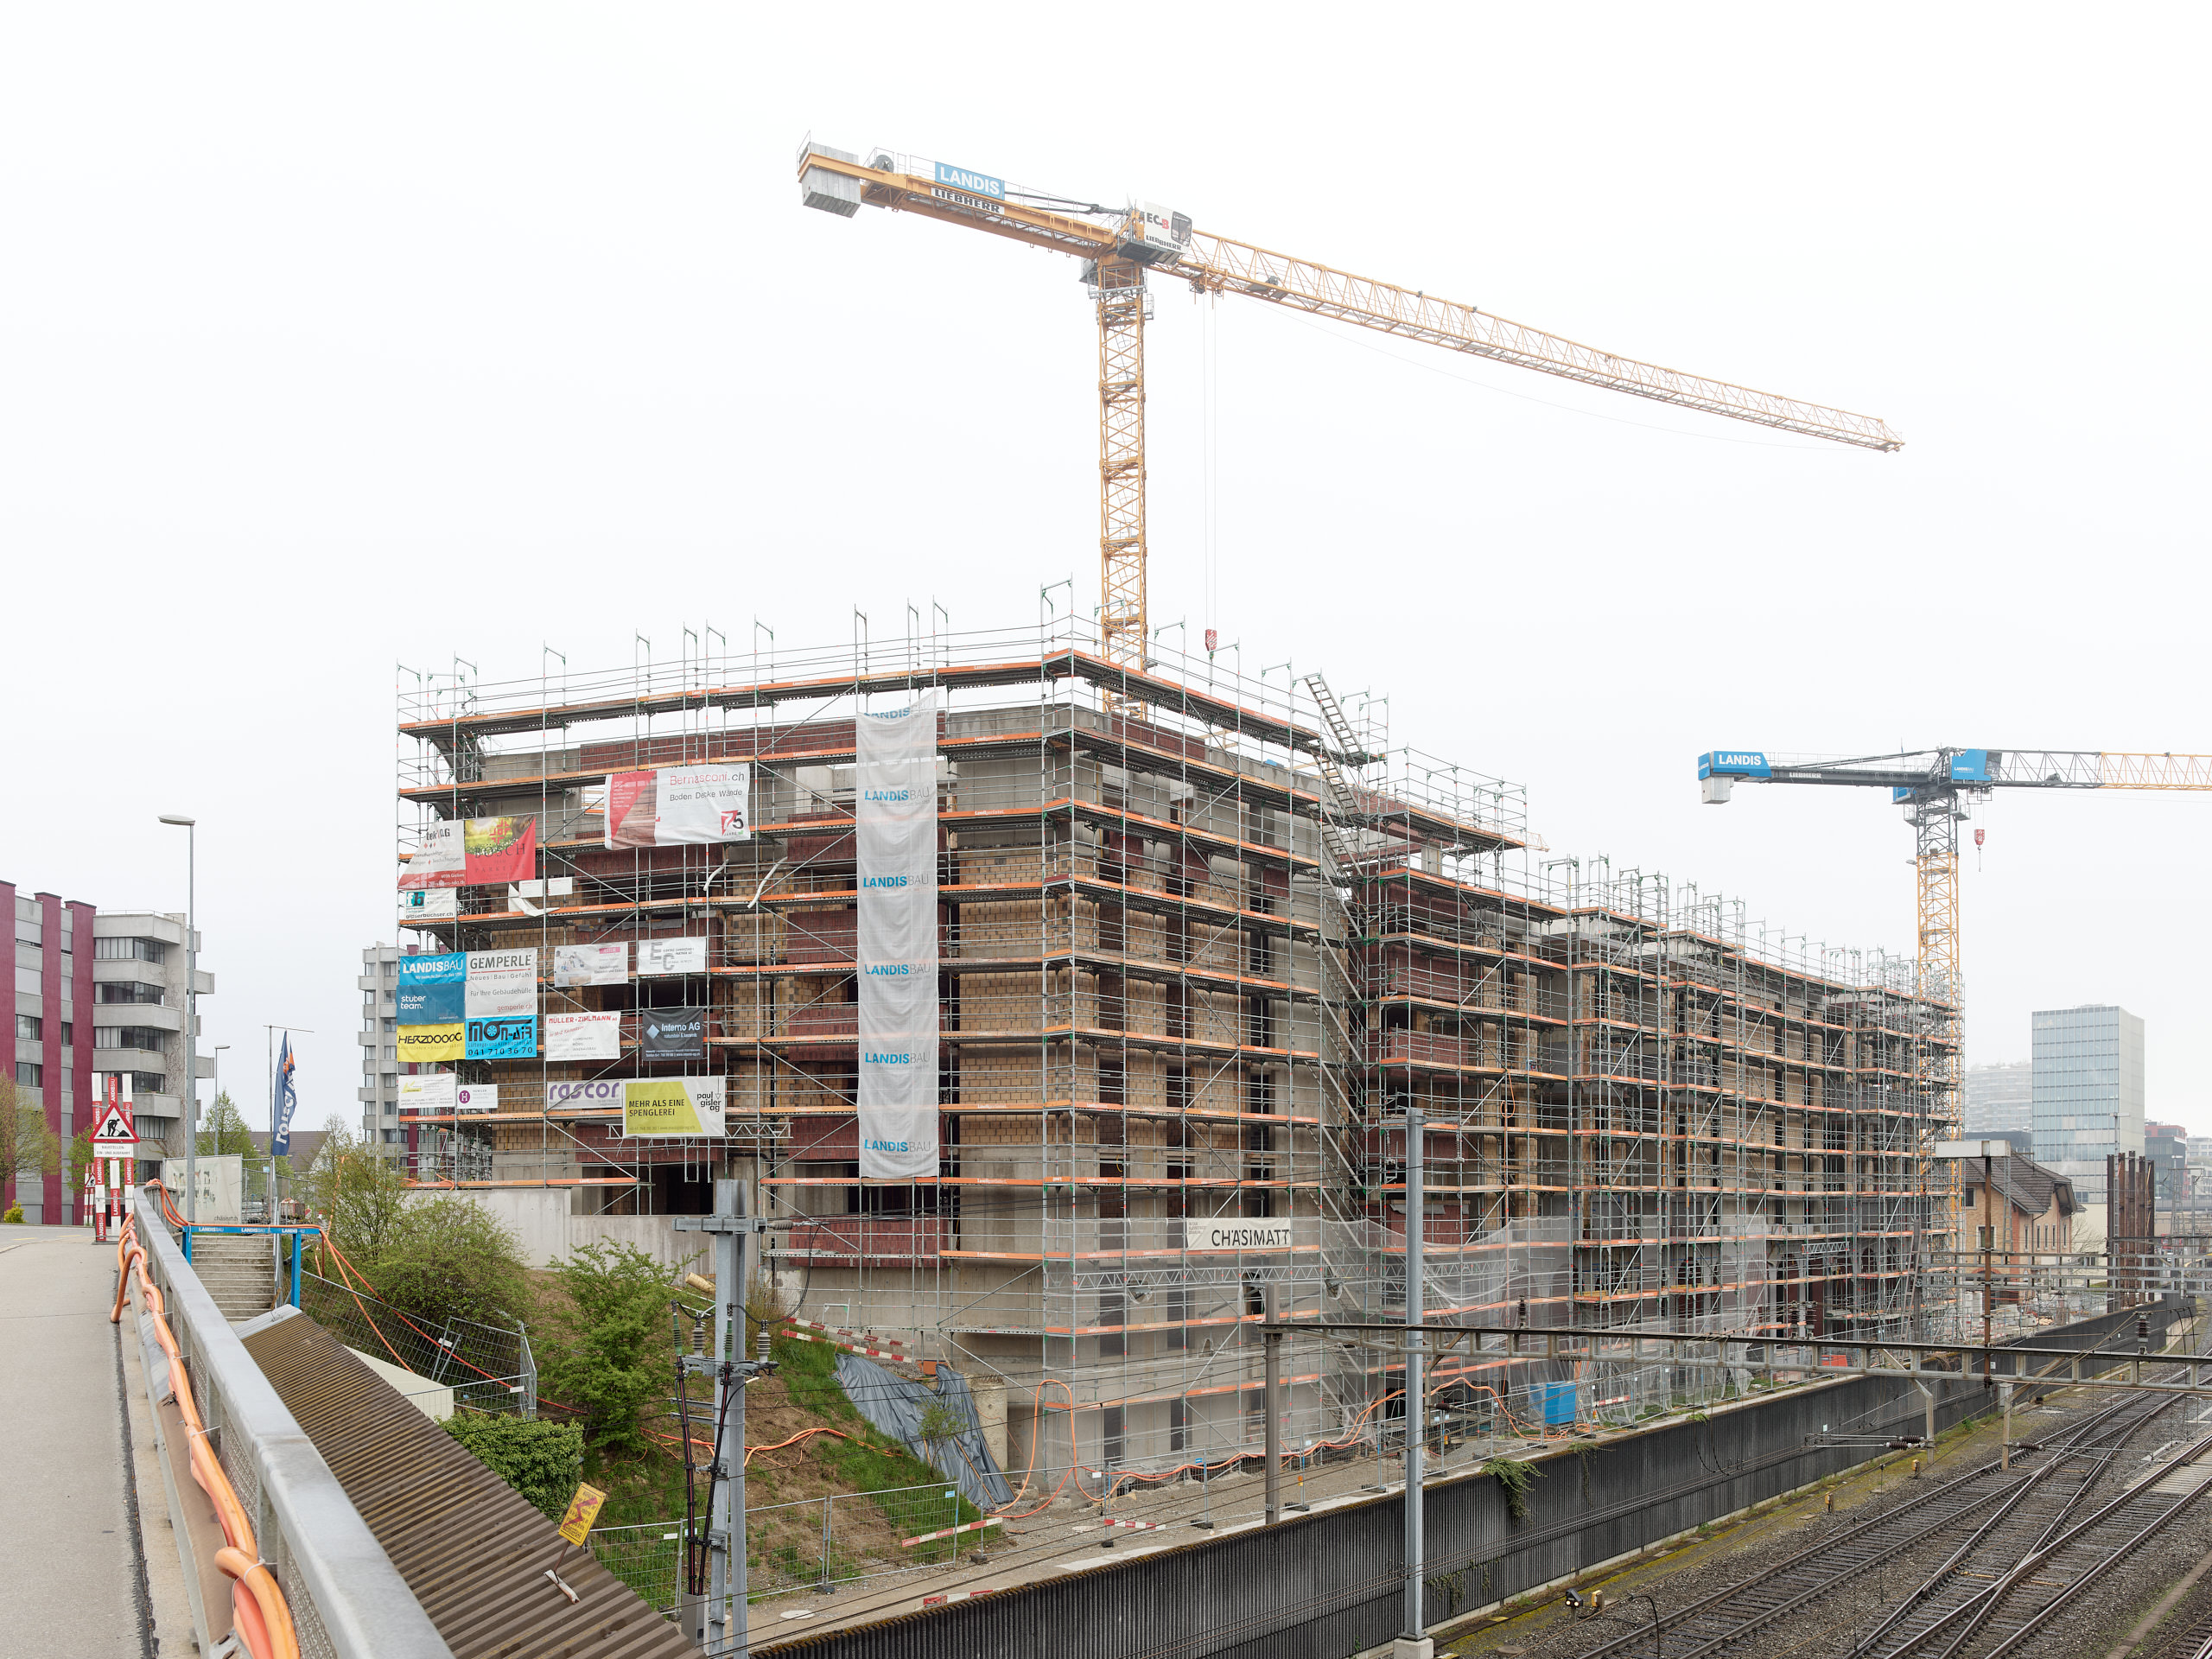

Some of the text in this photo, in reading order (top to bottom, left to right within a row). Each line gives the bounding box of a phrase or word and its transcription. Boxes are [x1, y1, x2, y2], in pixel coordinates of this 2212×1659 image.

[940, 166, 1000, 195] LANDIS
[934, 188, 1000, 213] LIEBHERR
[1146, 234, 1182, 251] LIEBHERR
[1719, 753, 1762, 766] LANDIS
[670, 772, 745, 785] Bernasconi.ch
[696, 791, 716, 799] Decke
[719, 789, 743, 798] Wände
[864, 786, 930, 802] LANDISBAU
[474, 843, 525, 858] BÖSCH
[863, 874, 929, 887] LANDISBAU
[402, 959, 463, 974] LANDISBAU
[470, 955, 531, 969] GEMPERLE
[864, 963, 931, 976] LANDISBAU
[497, 1003, 532, 1012] gemperle.ch
[661, 1021, 701, 1032] Interno AG
[865, 1051, 930, 1065] LANDISBAU
[549, 1082, 620, 1100] rascor
[696, 1091, 714, 1101] paul
[668, 1098, 684, 1107] EINE
[701, 1098, 721, 1107] gisler
[628, 1108, 675, 1116] SPENGLEREI
[864, 1139, 931, 1154] LANDISBAU
[1211, 1229, 1290, 1246] CHÄSIMATT
